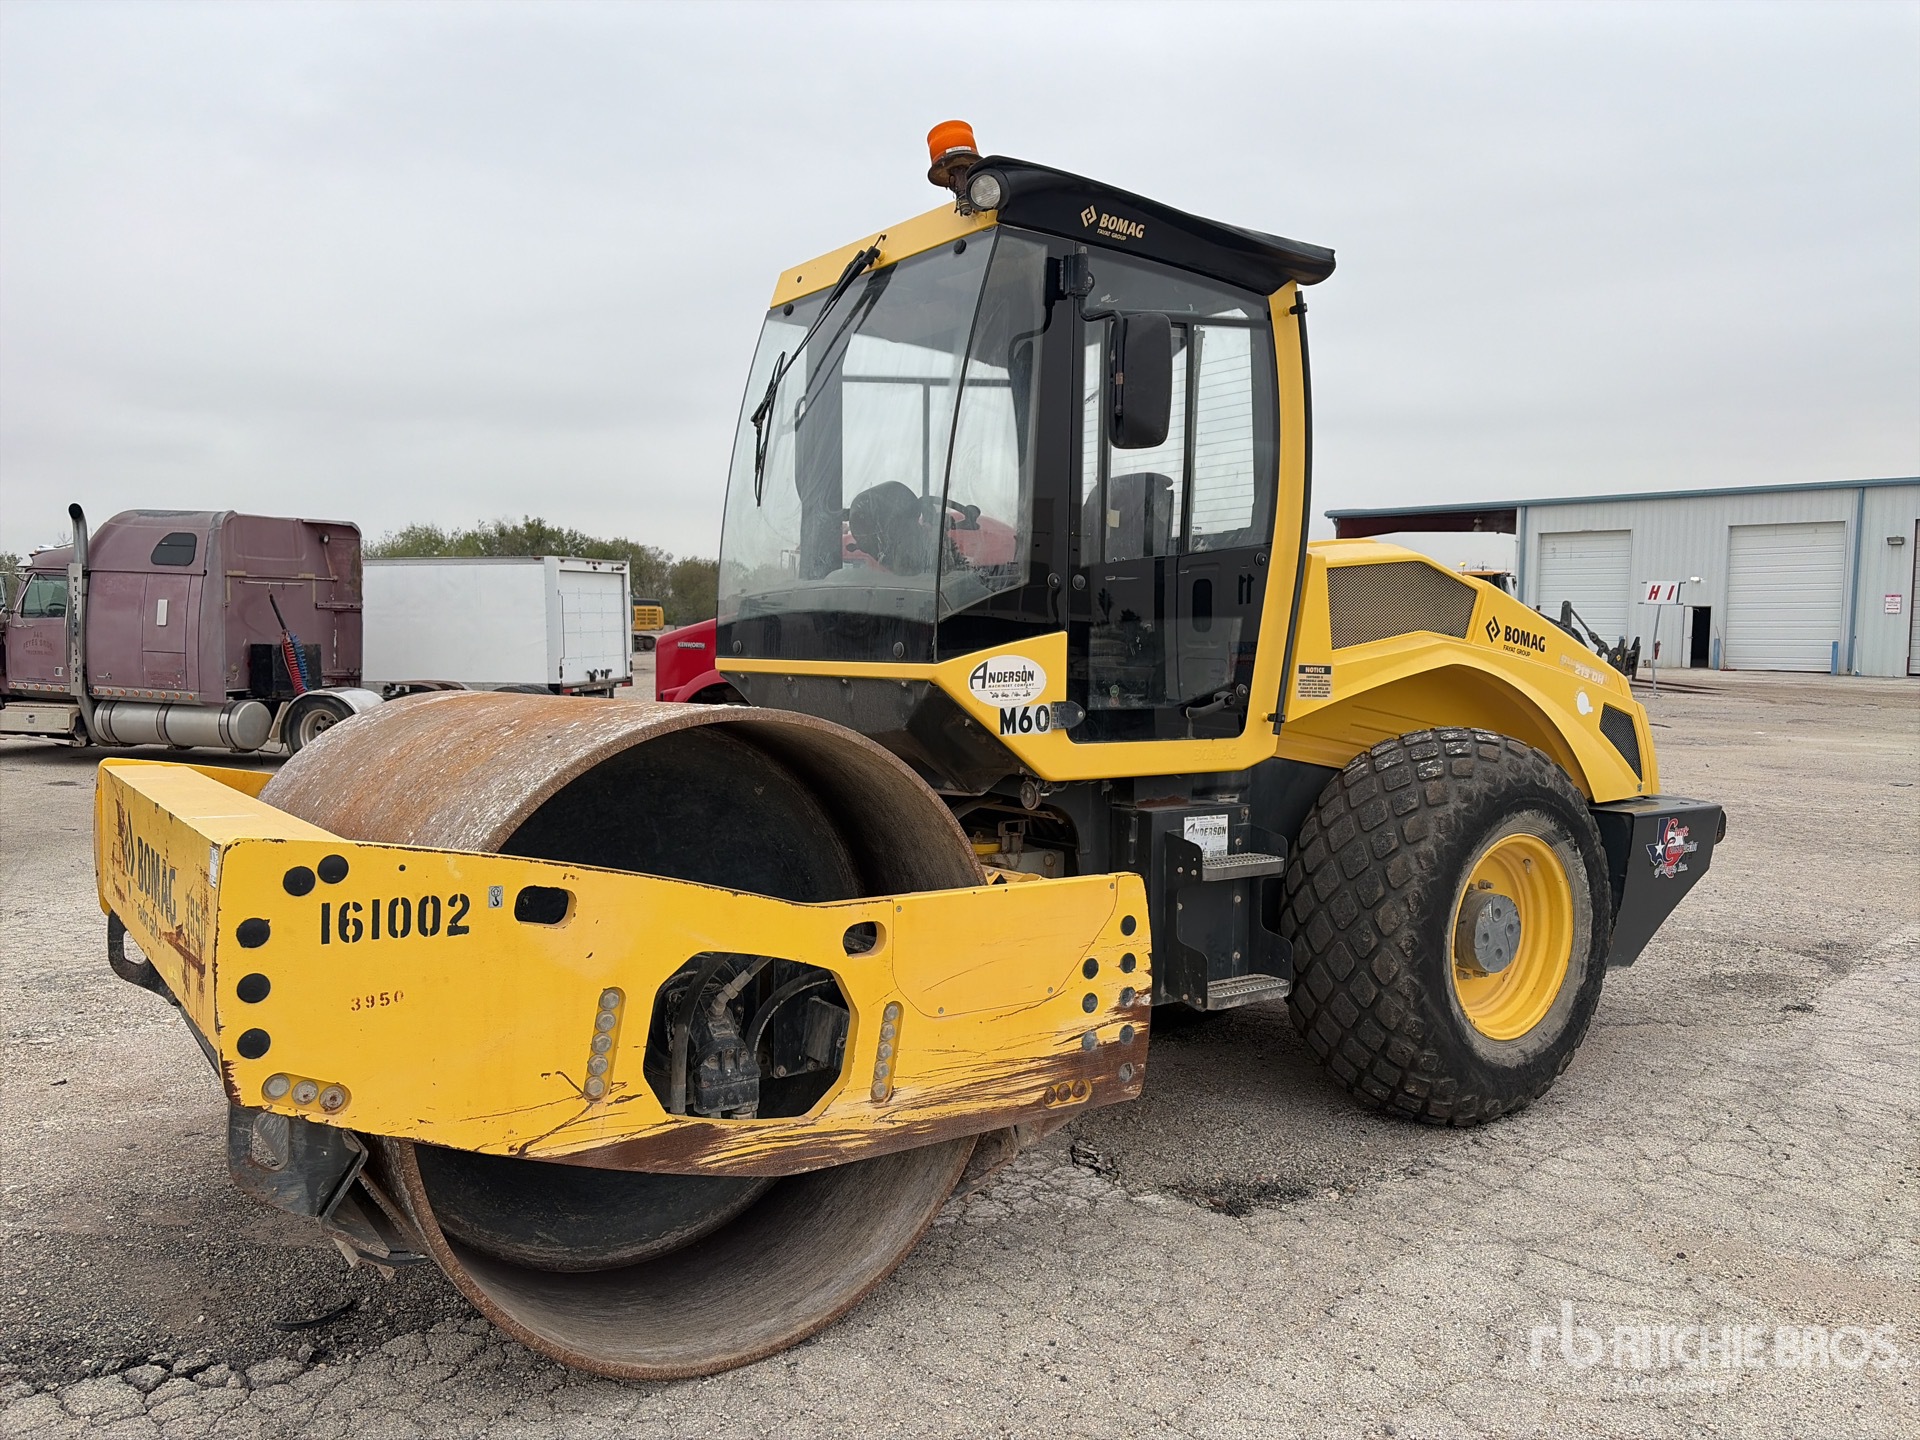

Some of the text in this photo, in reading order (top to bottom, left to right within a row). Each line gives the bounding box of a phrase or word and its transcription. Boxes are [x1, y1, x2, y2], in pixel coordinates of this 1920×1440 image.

[1097, 228, 1127, 241] FAYAT GROUP
[1099, 213, 1146, 238] BOMAG
[1503, 644, 1531, 657] FAYAT GROUP
[1504, 625, 1546, 653] BOMAG
[969, 661, 1034, 690] ANDERSON
[1305, 666, 1325, 674] NOTICE
[1000, 704, 1050, 734] M60
[1186, 822, 1227, 836] ANDERSON
[137, 836, 177, 929] BOMAG
[321, 893, 470, 945] 161002
[351, 990, 404, 1011] 3950
